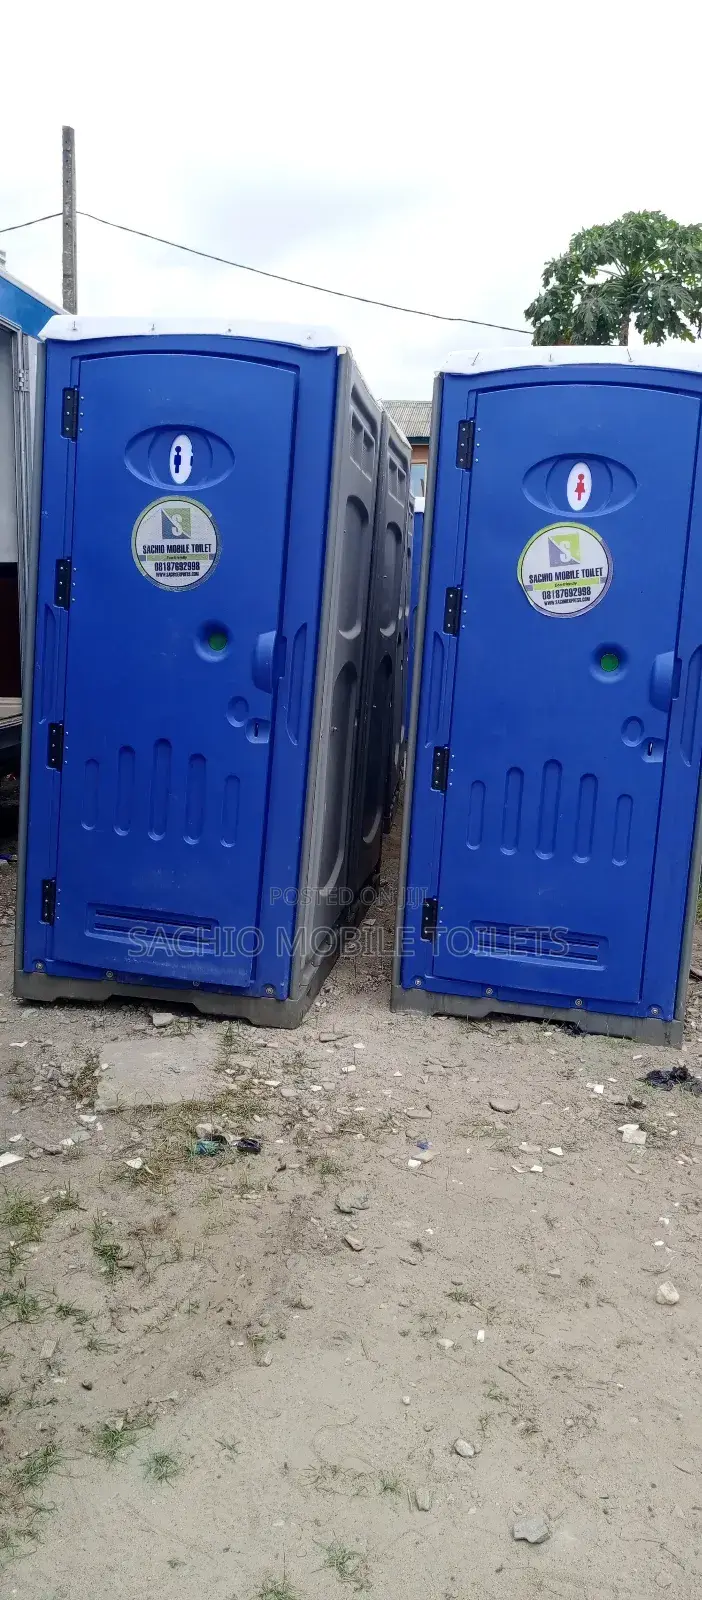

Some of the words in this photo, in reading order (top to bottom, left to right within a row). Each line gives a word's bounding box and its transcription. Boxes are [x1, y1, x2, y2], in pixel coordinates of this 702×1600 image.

[171, 513, 183, 536] S
[142, 544, 165, 554] SACHIO
[166, 544, 190, 554] MOBILE
[192, 543, 212, 553] TOILET
[559, 540, 572, 563] S
[154, 561, 201, 571] 08187692998
[529, 573, 553, 584] SACHIO
[555, 570, 580, 581] MOBILE
[581, 568, 603, 578] TOILET
